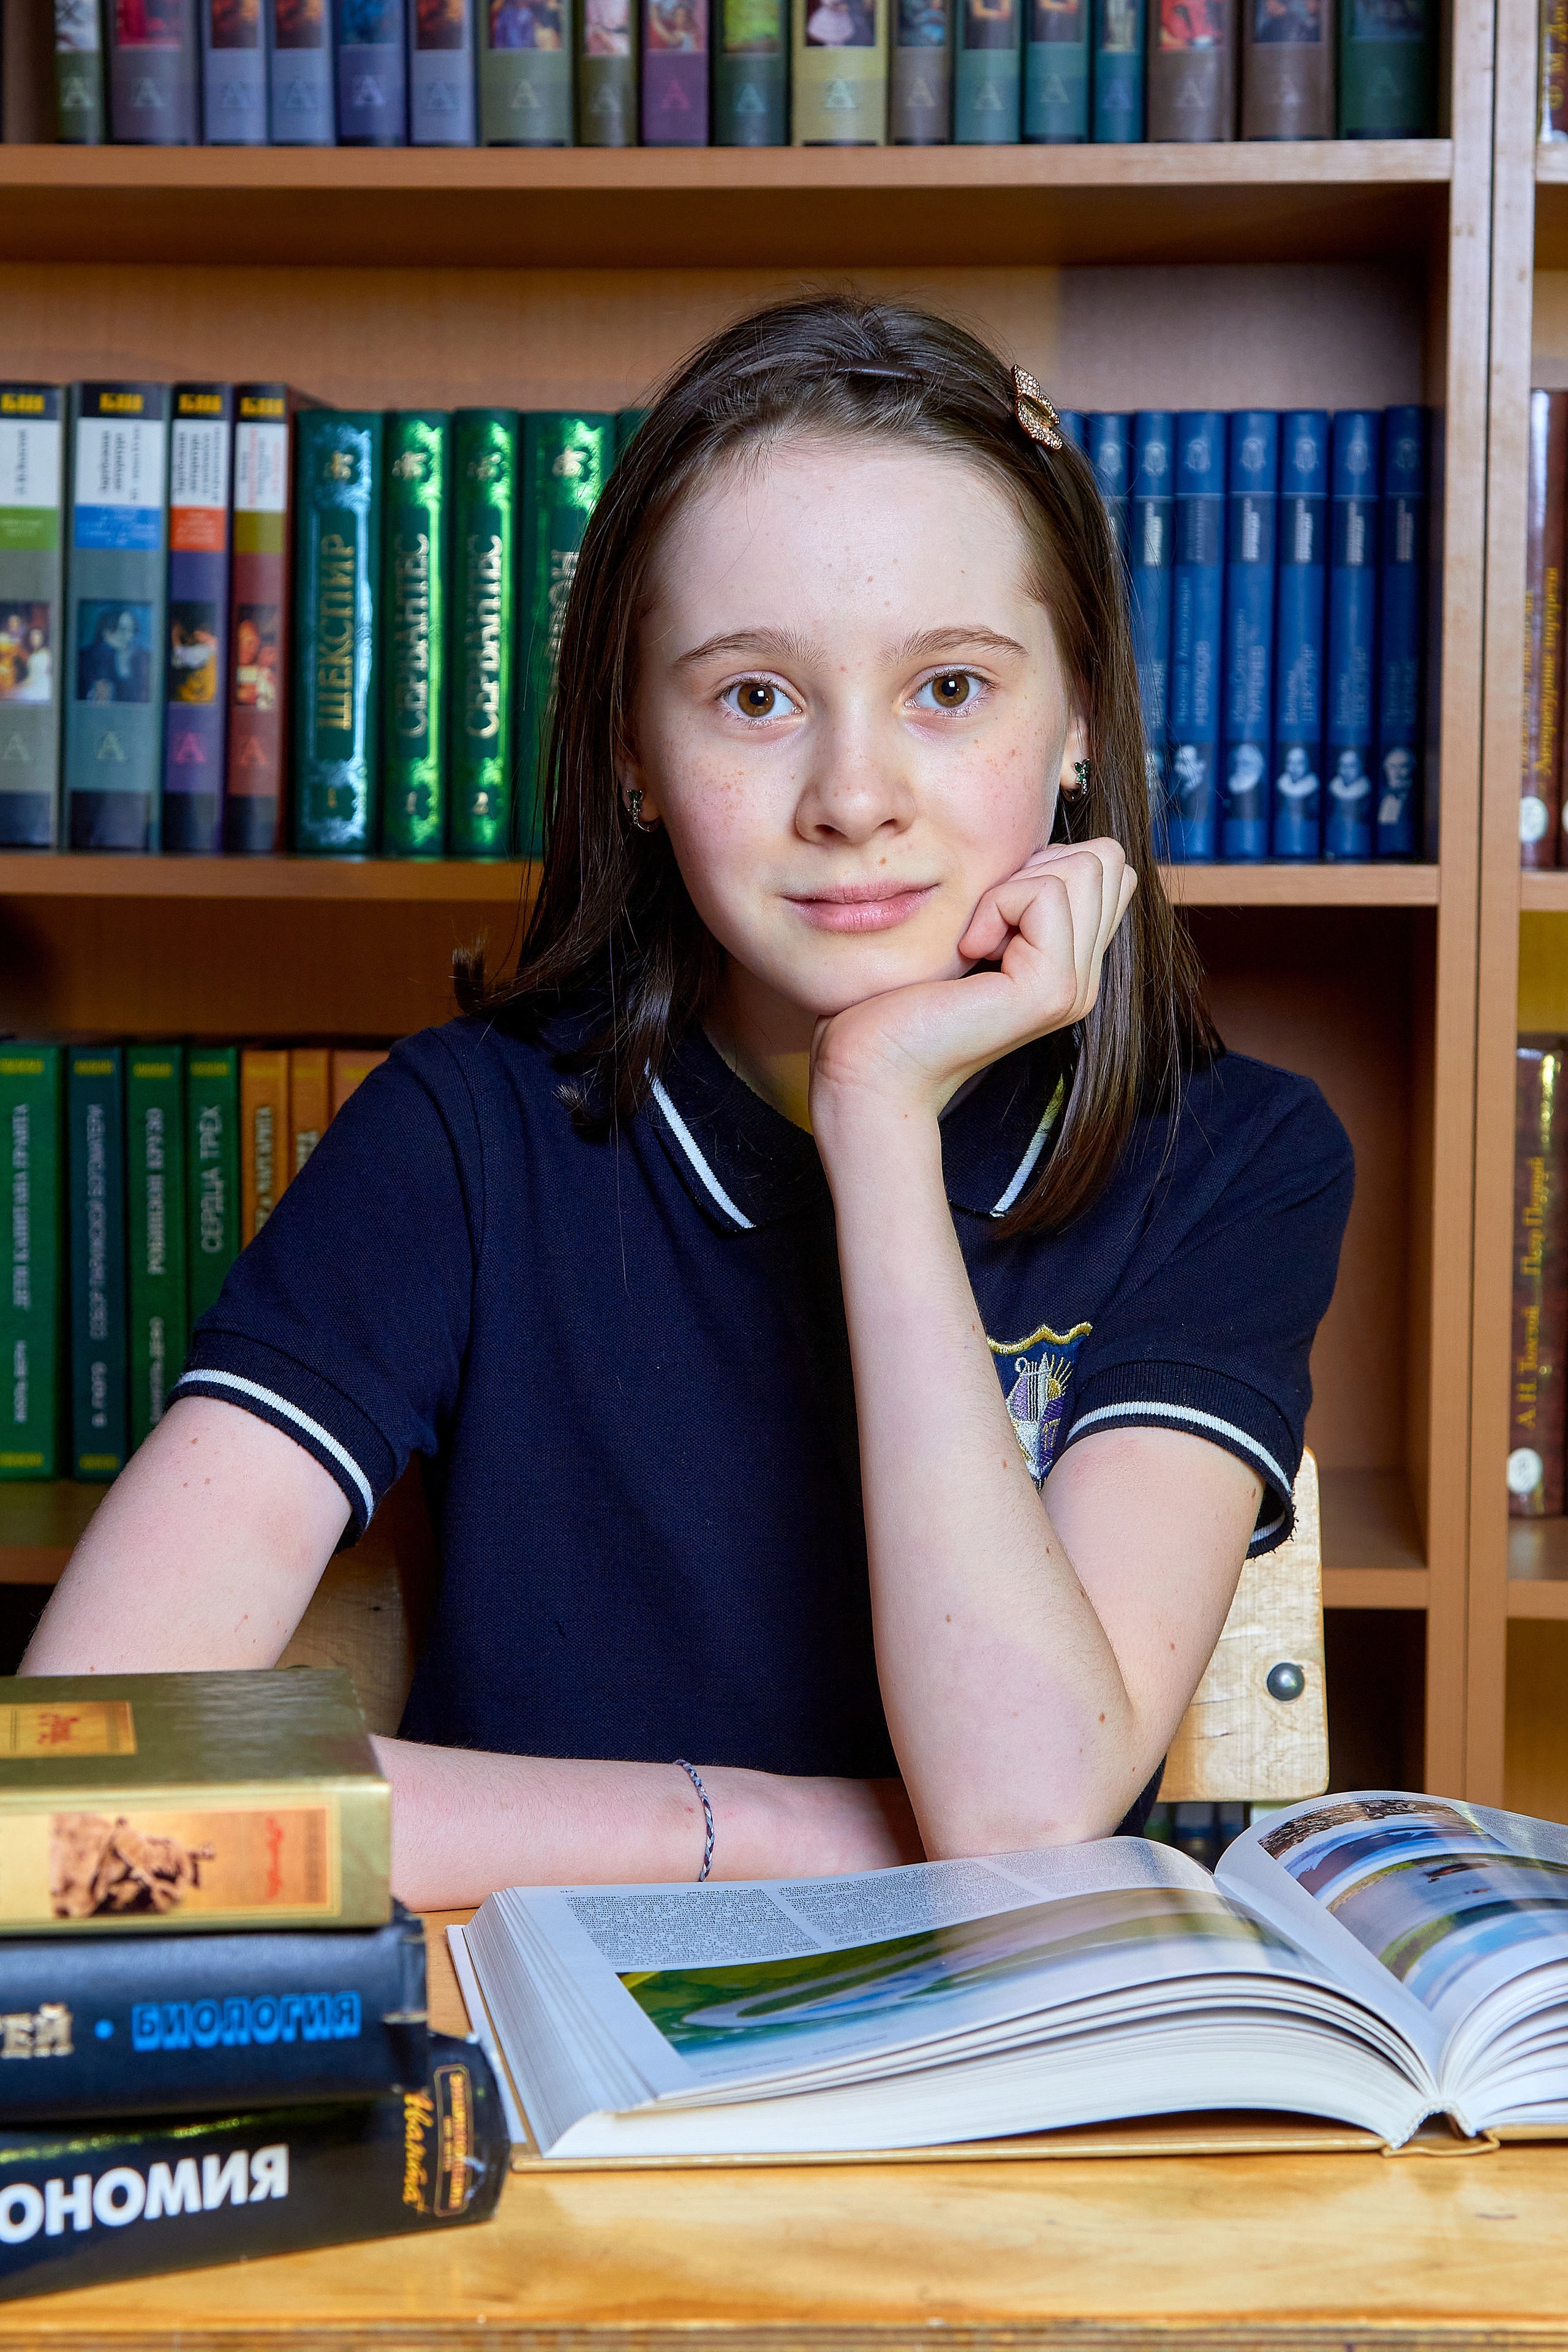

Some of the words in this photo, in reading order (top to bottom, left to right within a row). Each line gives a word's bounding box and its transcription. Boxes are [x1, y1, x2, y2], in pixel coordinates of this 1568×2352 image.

[317, 534, 355, 731] ШЕКСПИР
[394, 532, 429, 739] СЕРВАНТЕС
[464, 532, 502, 739] СЕРВАНТЕС
[2, 734, 31, 761] А
[96, 732, 125, 761] А
[176, 734, 206, 763] А
[240, 737, 268, 766] А
[200, 1166, 225, 1254] СЕРДЦА
[0, 2003, 75, 2060] ЕЙ
[131, 1990, 363, 2052] БИОЛОГИЯ
[0, 2143, 290, 2246] ОНОМИЯ
